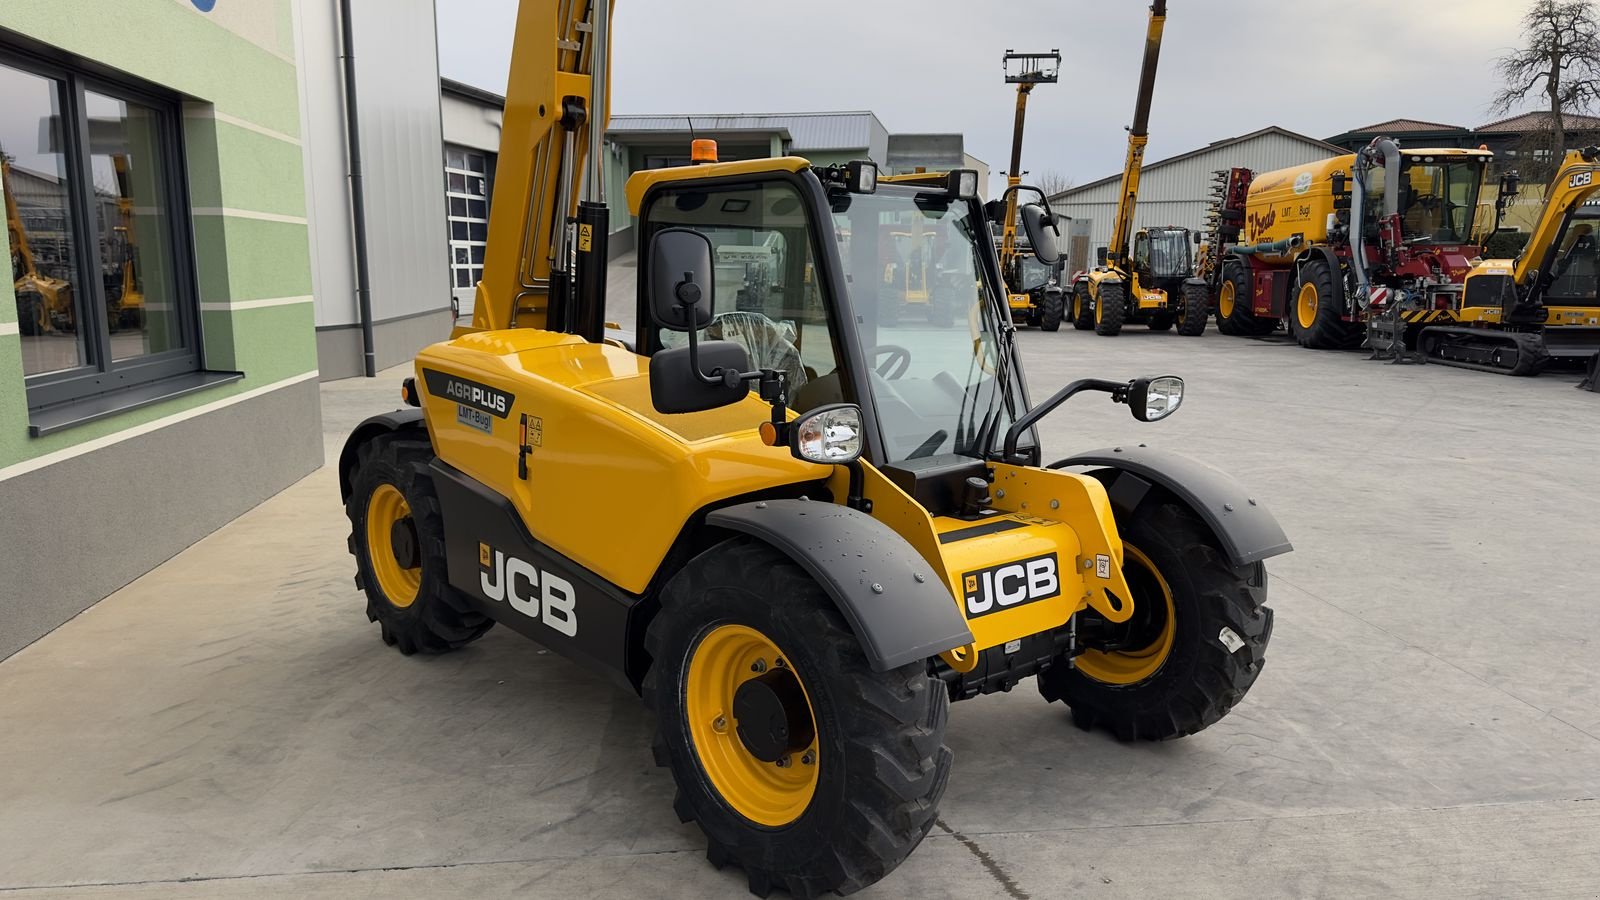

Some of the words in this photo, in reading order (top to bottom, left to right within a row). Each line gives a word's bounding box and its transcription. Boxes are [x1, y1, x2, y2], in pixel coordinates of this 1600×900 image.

[1569, 171, 1592, 188] JCB
[1281, 206, 1292, 218] LMT
[480, 550, 578, 638] JCB
[967, 557, 1058, 614] JCB
